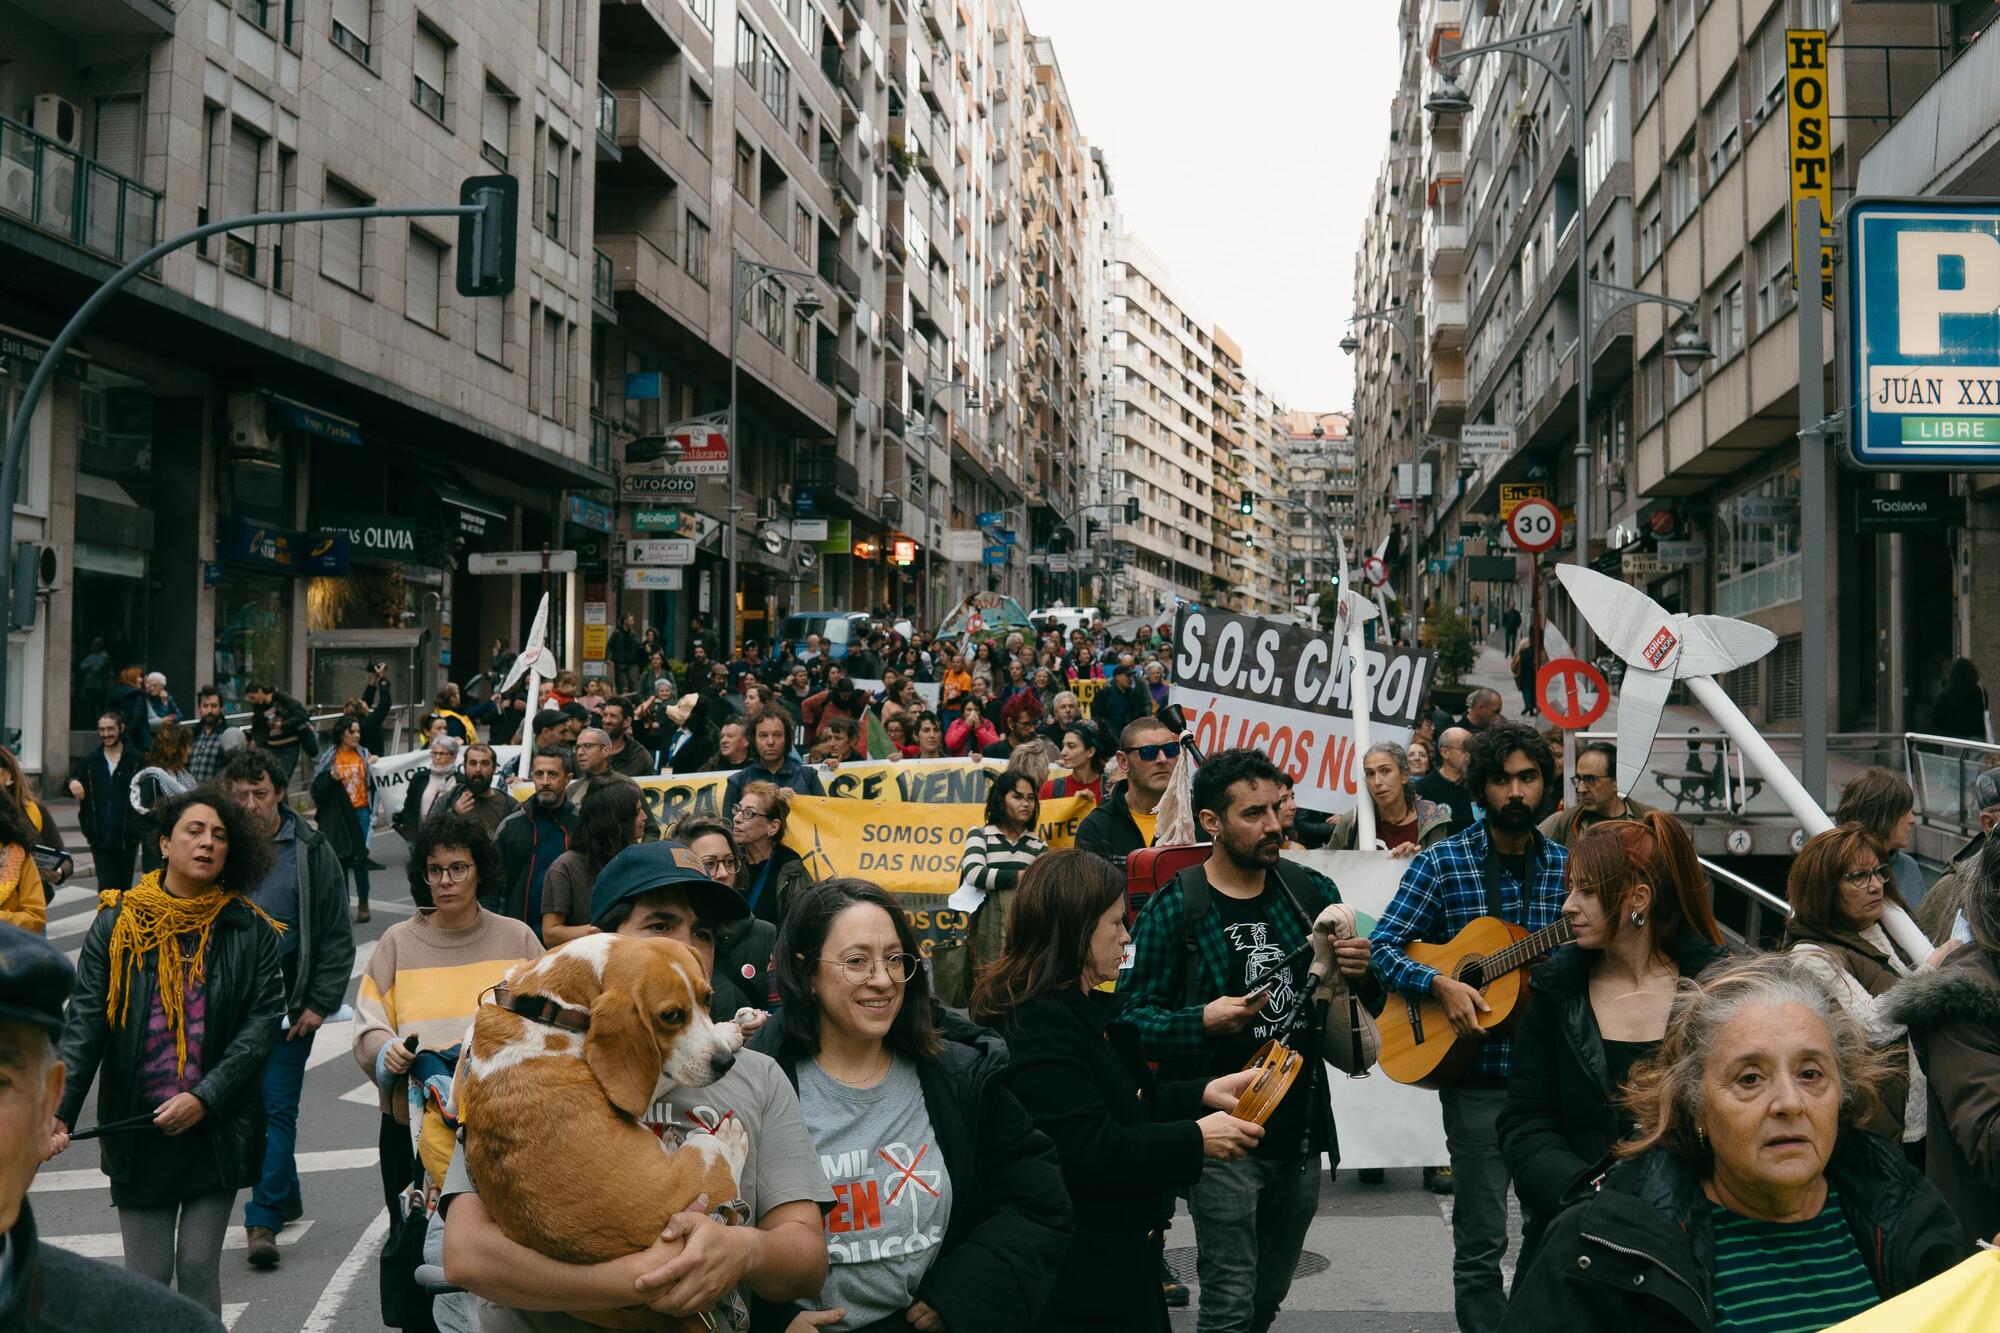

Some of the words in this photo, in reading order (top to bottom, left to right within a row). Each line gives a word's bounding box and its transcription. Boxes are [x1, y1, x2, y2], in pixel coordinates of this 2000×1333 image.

[1897, 231, 2000, 355] P
[1879, 377, 1943, 404] JUAN
[1920, 421, 1985, 438] LIBRE
[1519, 516, 1551, 534] 30
[364, 526, 414, 550] OLIVIA
[1177, 613, 1284, 698] S.O.S.
[862, 823, 943, 845] SOMOS
[859, 853, 904, 871] DAS
[820, 1149, 875, 1180] MIL
